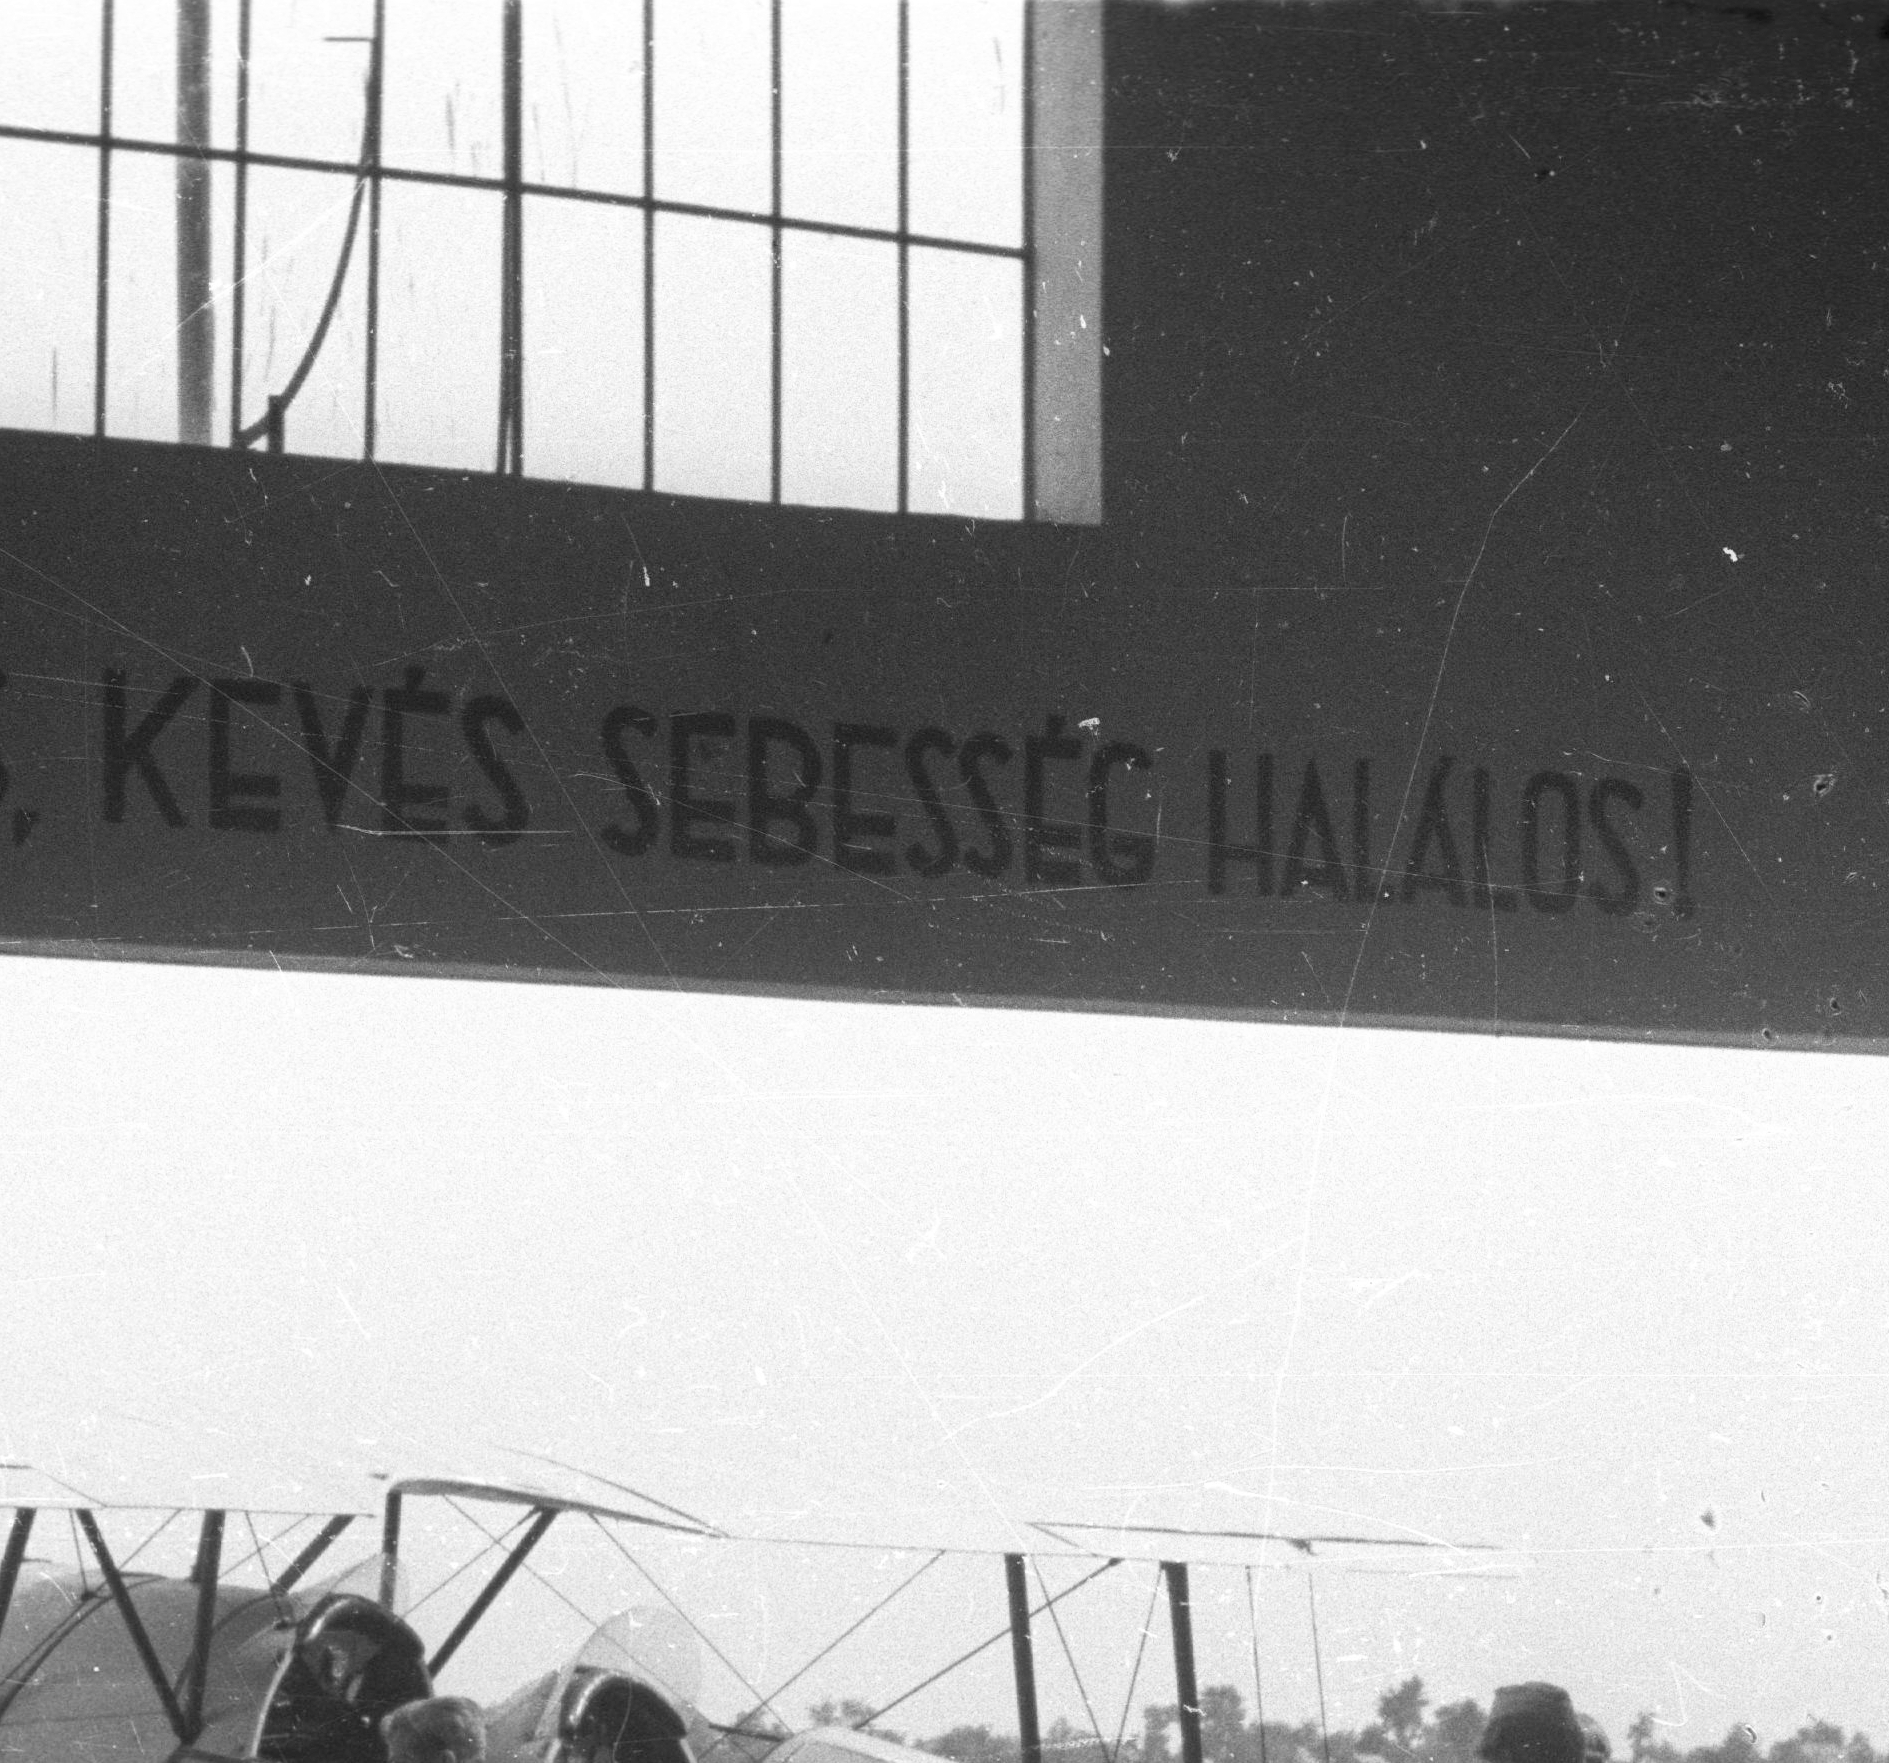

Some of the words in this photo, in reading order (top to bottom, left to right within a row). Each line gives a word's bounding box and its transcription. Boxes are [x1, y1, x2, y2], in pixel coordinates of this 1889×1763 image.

[103, 666, 529, 845] KEVÉS
[602, 704, 1156, 888] SEBESSÉG
[1210, 750, 1695, 920] HALÁLOS!
